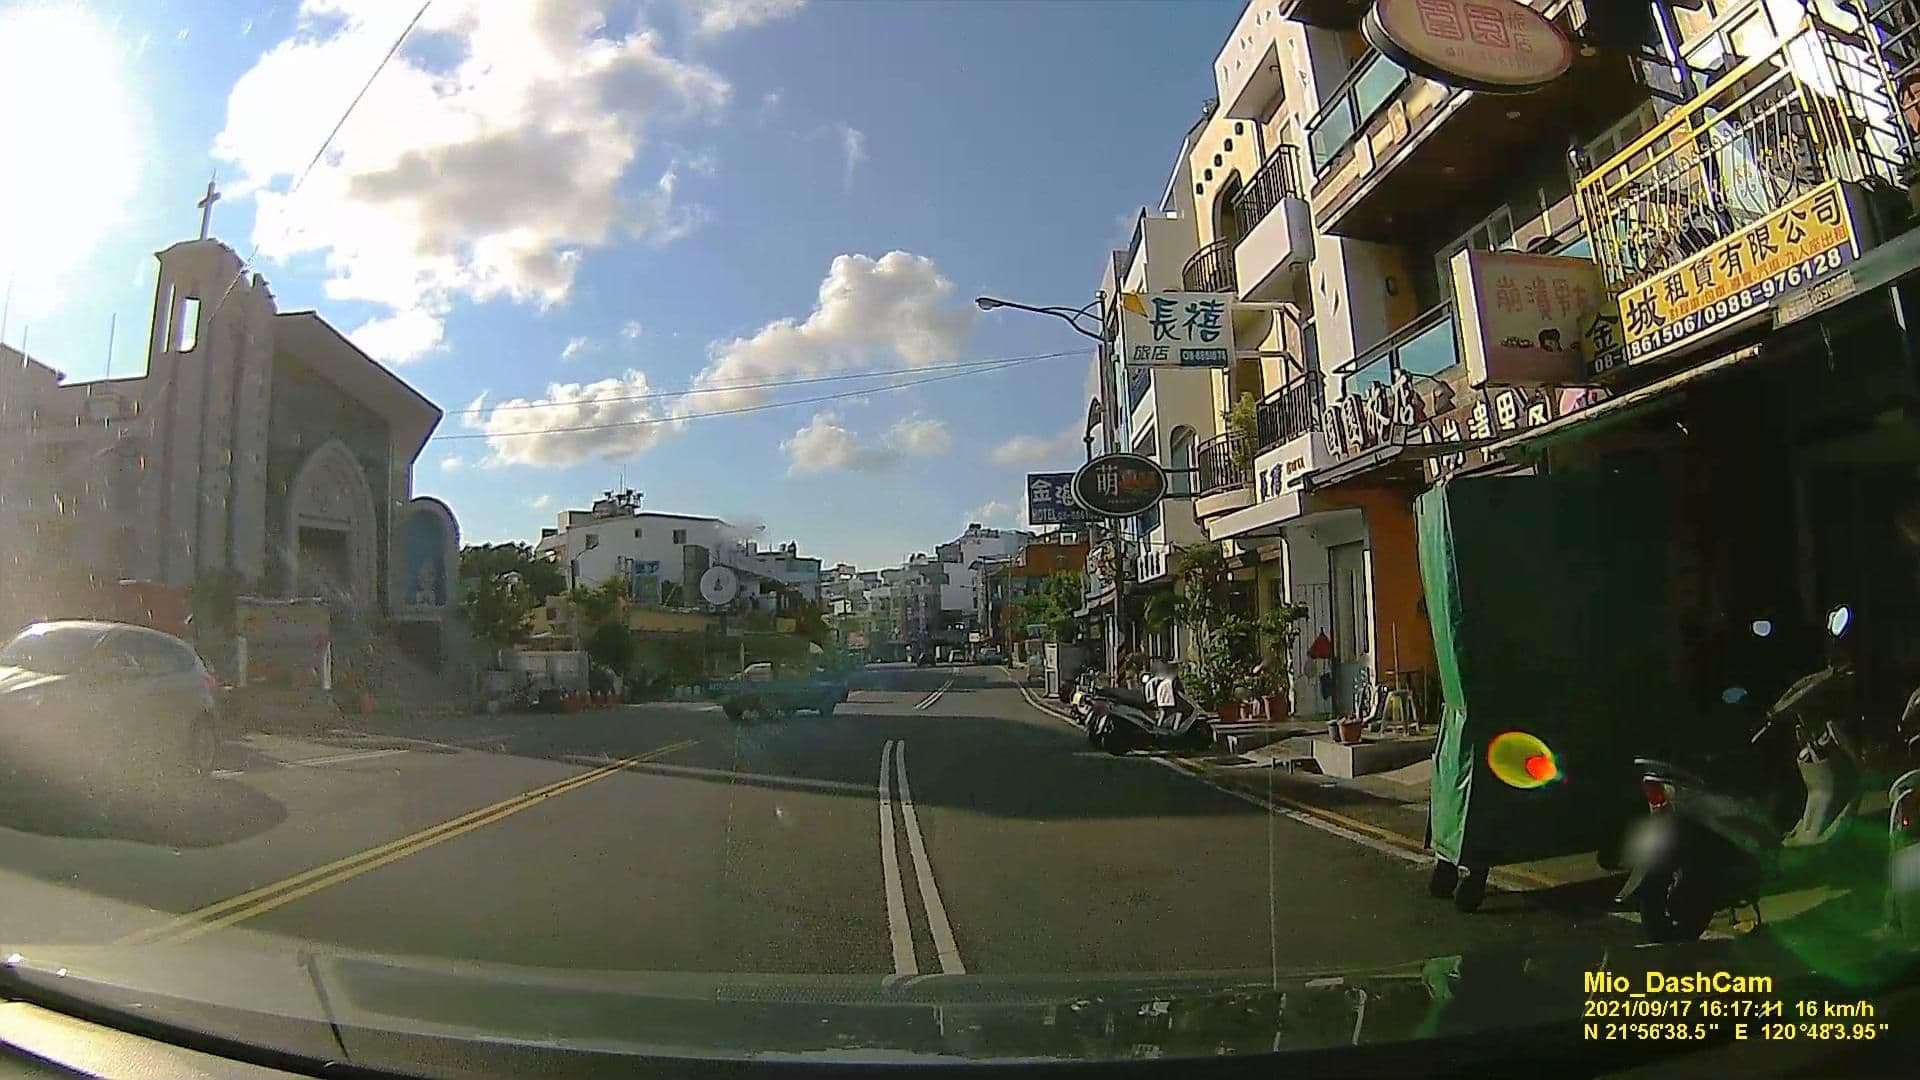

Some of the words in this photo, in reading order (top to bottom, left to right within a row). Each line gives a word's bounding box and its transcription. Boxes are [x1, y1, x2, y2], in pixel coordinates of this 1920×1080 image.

[1149, 297, 1225, 342] 長禧
[1133, 344, 1171, 361] 旅店
[1095, 464, 1121, 497] 萌
